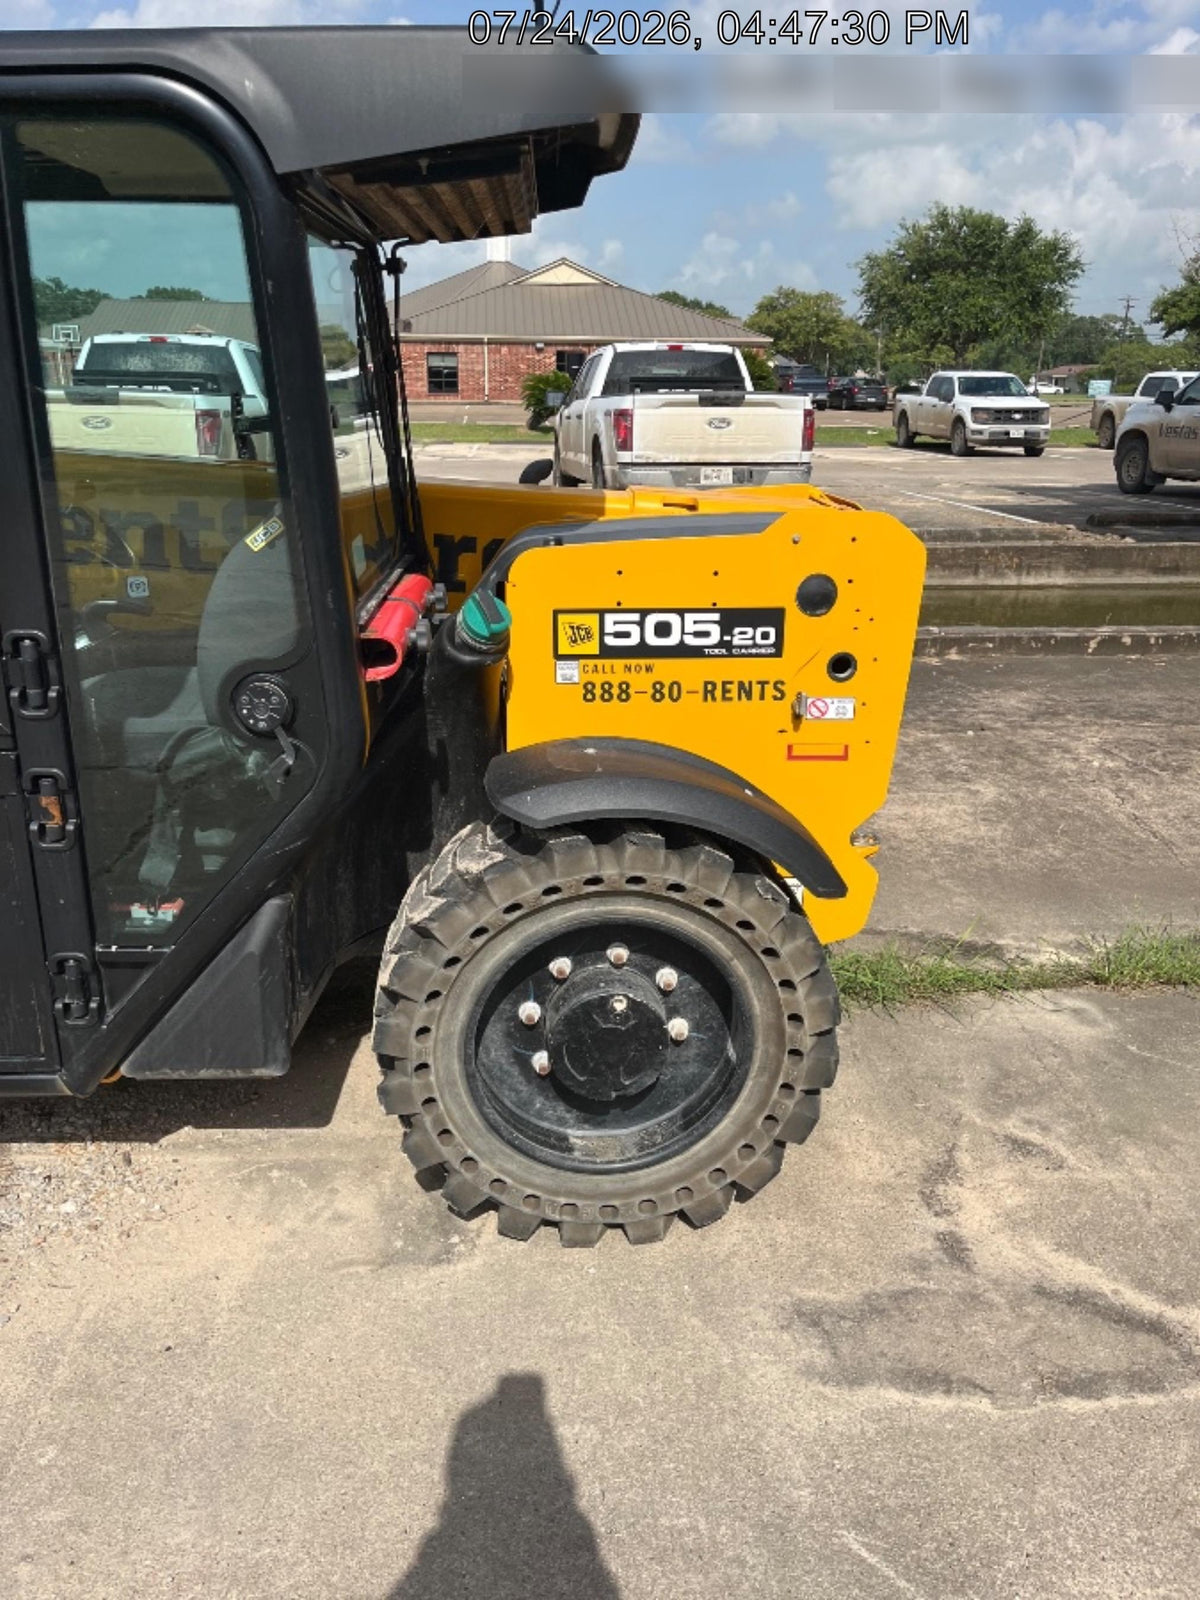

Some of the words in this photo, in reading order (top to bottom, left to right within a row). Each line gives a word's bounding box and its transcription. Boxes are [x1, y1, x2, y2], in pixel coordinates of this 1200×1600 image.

[568, 624, 593, 647] JCB
[604, 613, 776, 646] 505-20
[732, 647, 776, 655] CARRIER
[583, 663, 616, 674] CALL
[623, 663, 655, 674] NOW
[582, 680, 787, 703] 888-80-RENTS
